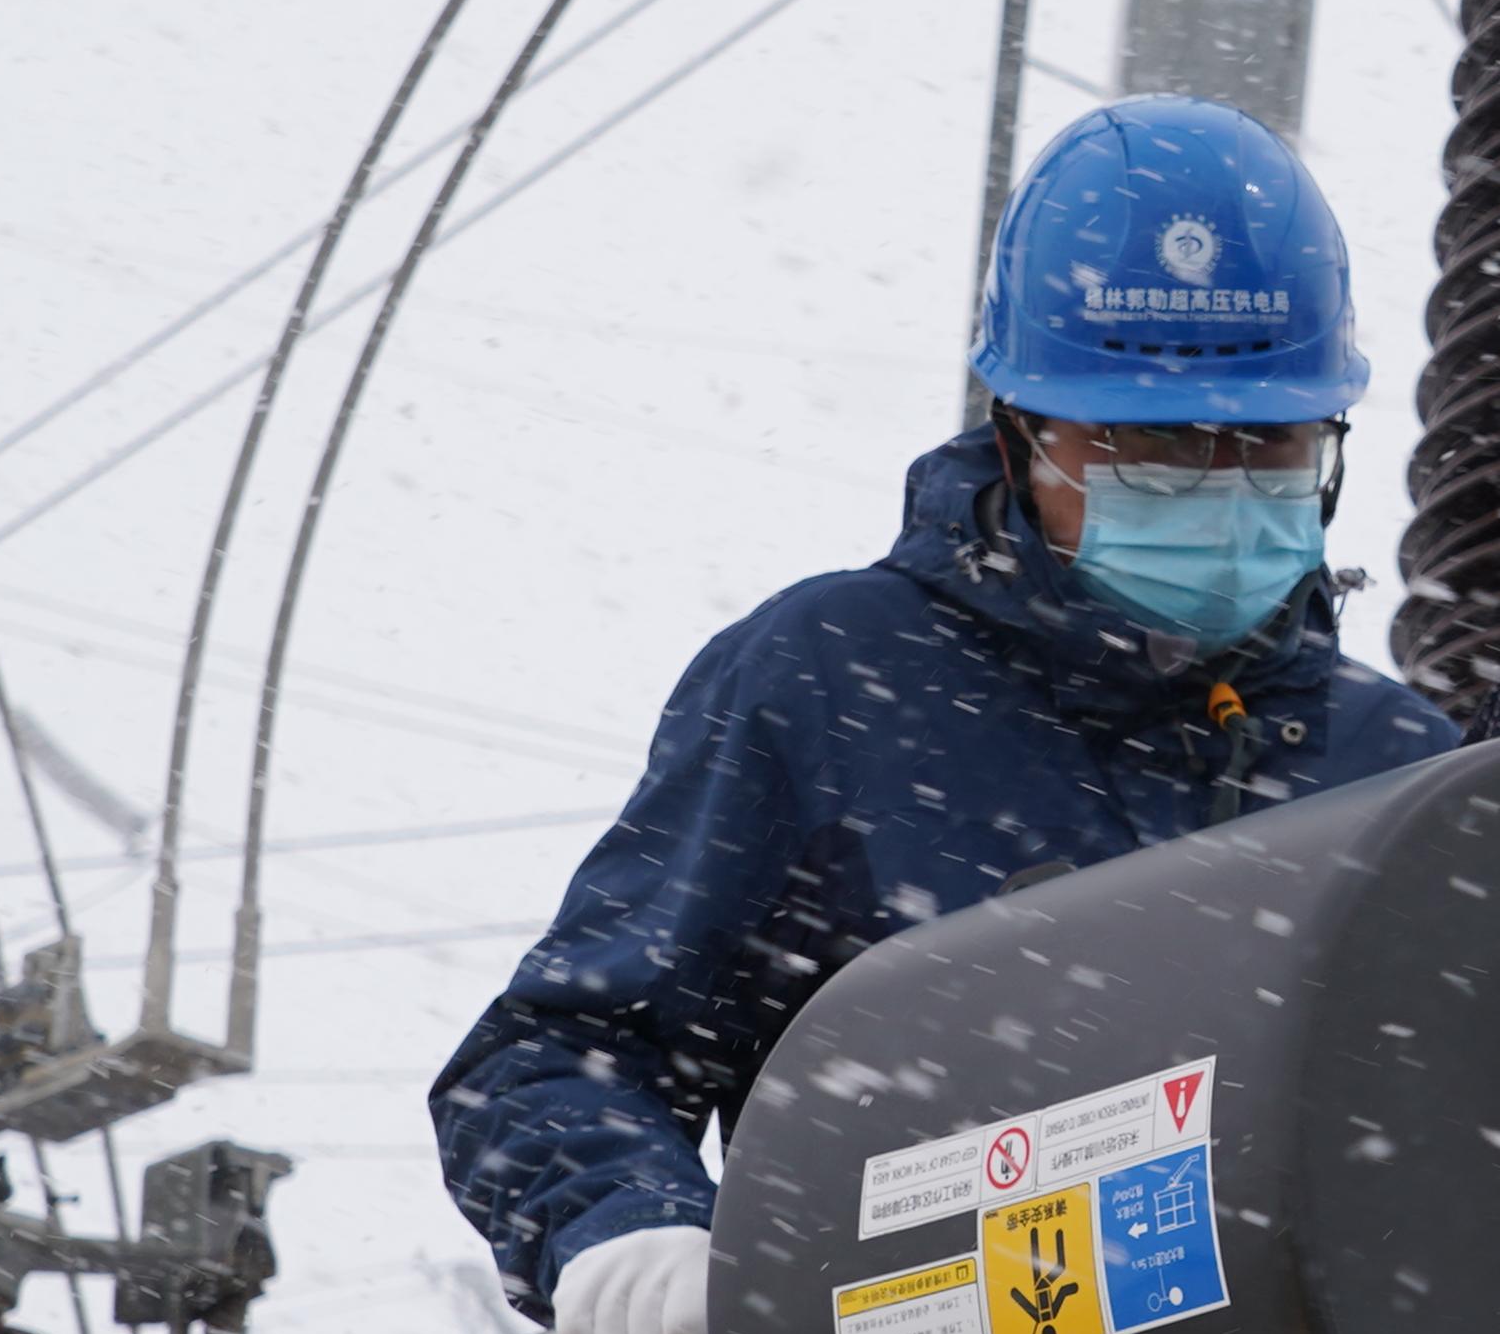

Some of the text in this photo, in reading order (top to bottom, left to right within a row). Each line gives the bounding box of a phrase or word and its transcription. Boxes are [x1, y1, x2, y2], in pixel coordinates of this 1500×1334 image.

[1051, 1129, 1139, 1171] 未经培训禁止操作
[872, 1179, 972, 1222] 保持工作区域无障碍物
[1006, 1198, 1067, 1232] 请系安全带
